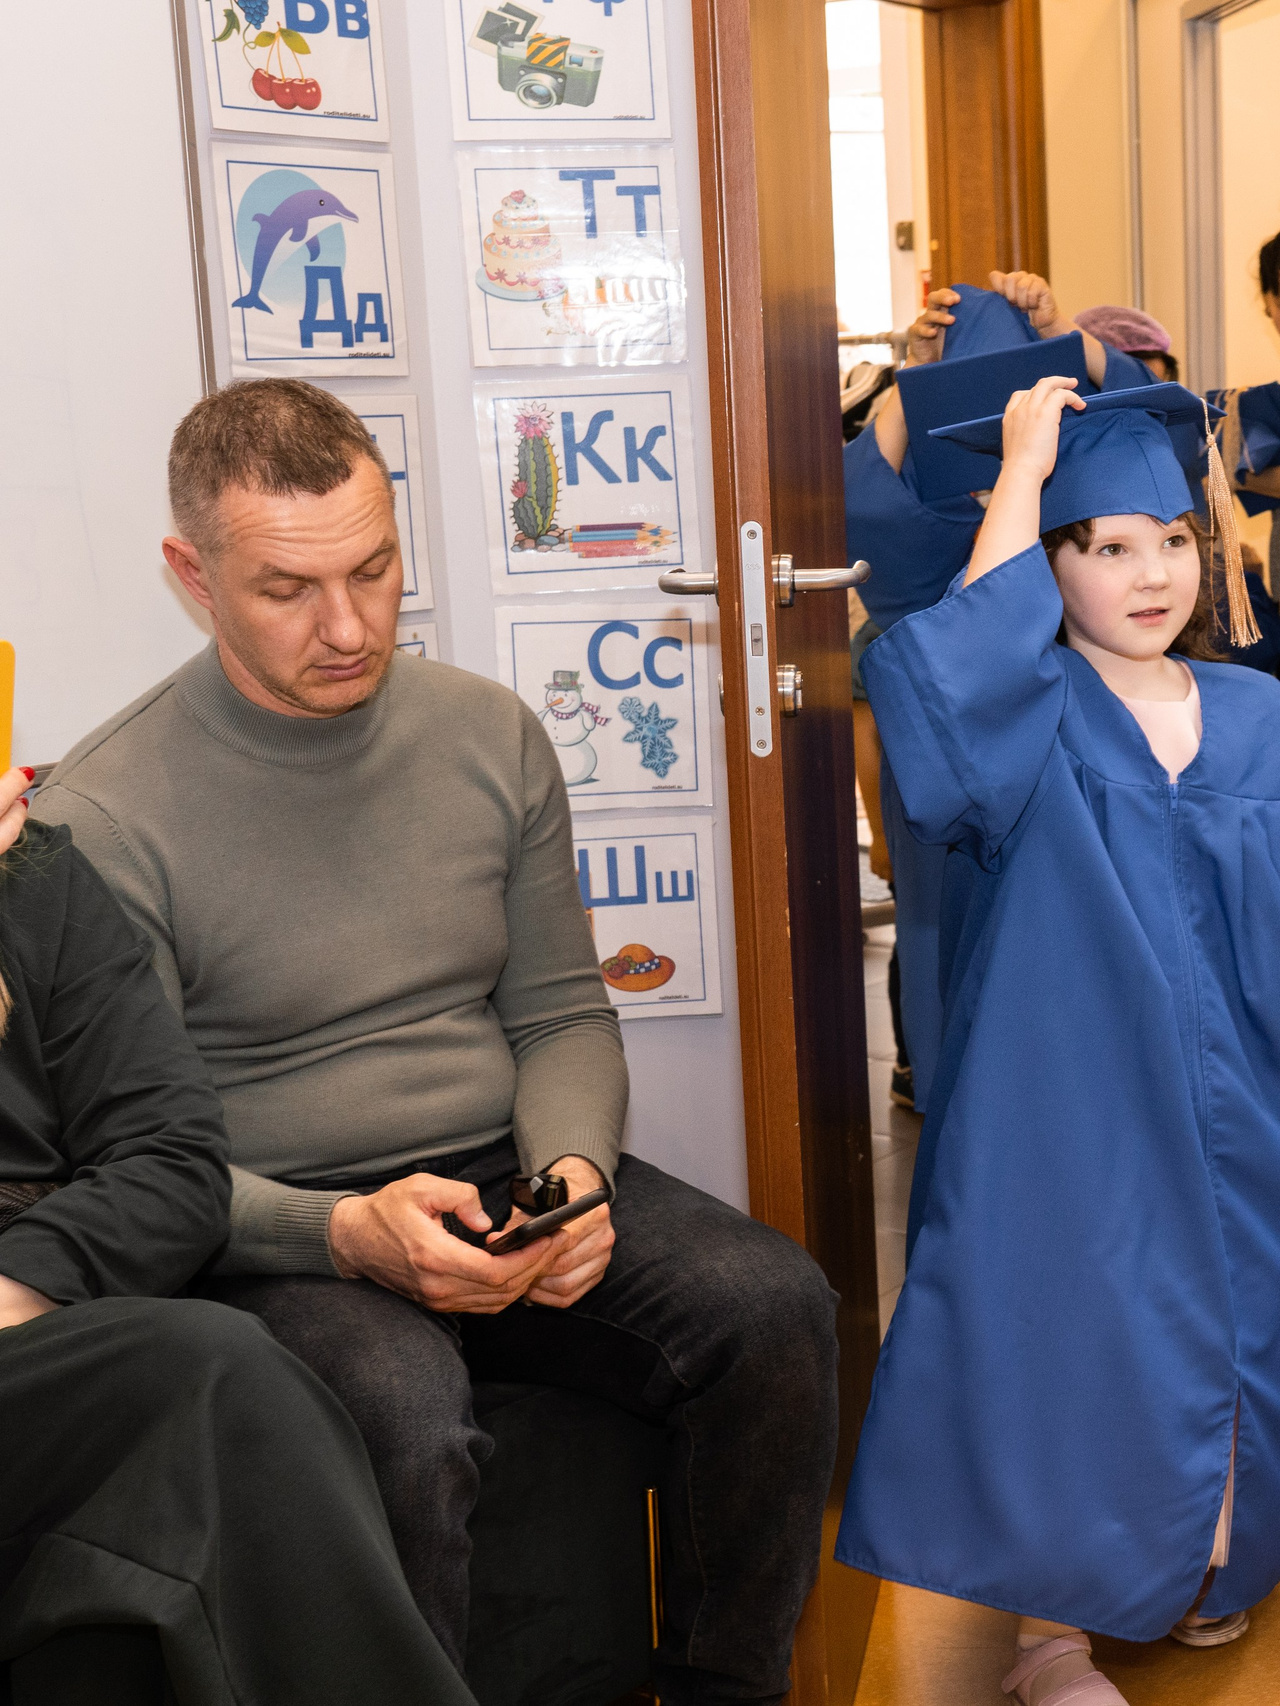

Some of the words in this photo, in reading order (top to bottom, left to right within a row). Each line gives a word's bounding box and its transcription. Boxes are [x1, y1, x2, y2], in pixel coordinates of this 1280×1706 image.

[299, 265, 389, 348] Дд
[560, 409, 674, 486] Кк
[587, 620, 684, 690] Сс
[577, 845, 696, 907] Шш
